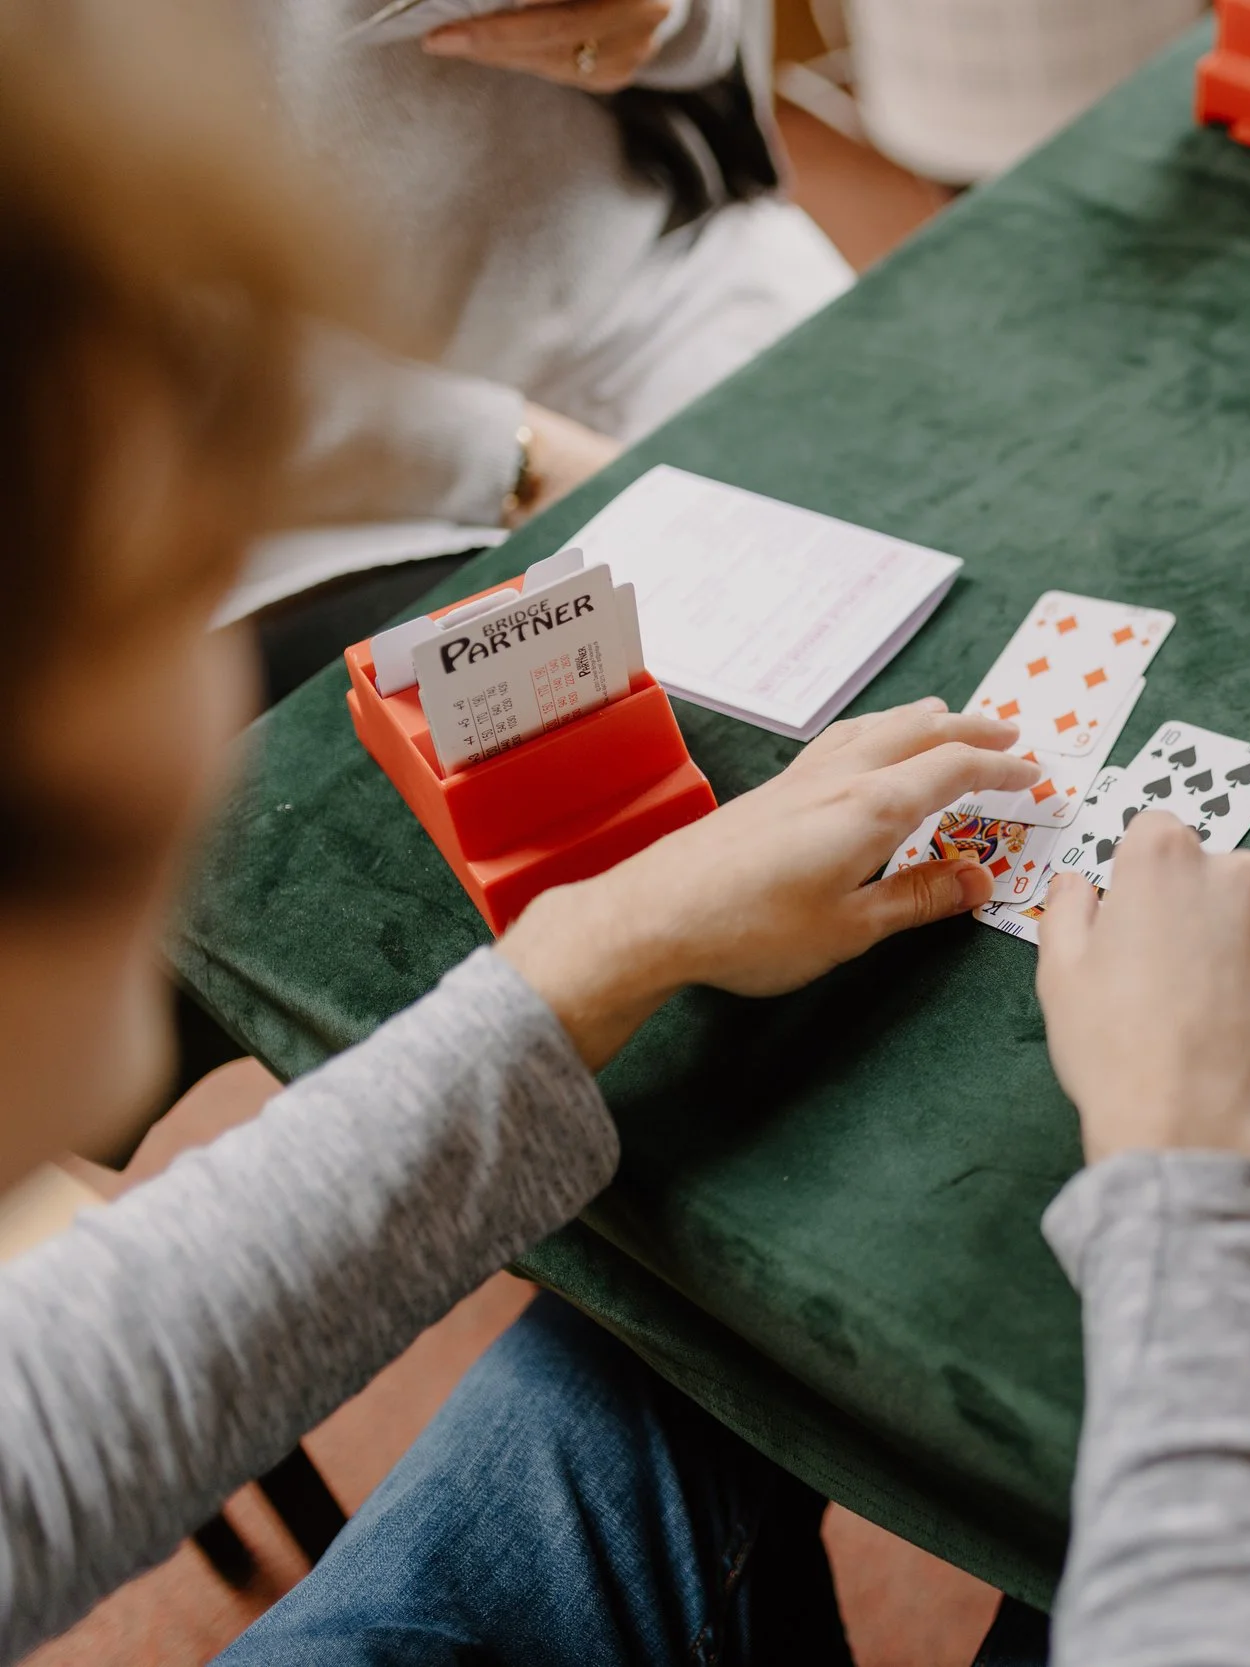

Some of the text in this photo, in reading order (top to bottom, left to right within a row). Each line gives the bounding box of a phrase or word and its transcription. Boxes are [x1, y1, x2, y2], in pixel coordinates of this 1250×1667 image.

[482, 599, 552, 637] BRIDGE
[440, 594, 595, 674] PARTNER
[1160, 729, 1181, 746] 10
[1097, 775, 1118, 793] K
[1013, 876, 1029, 894] Q
